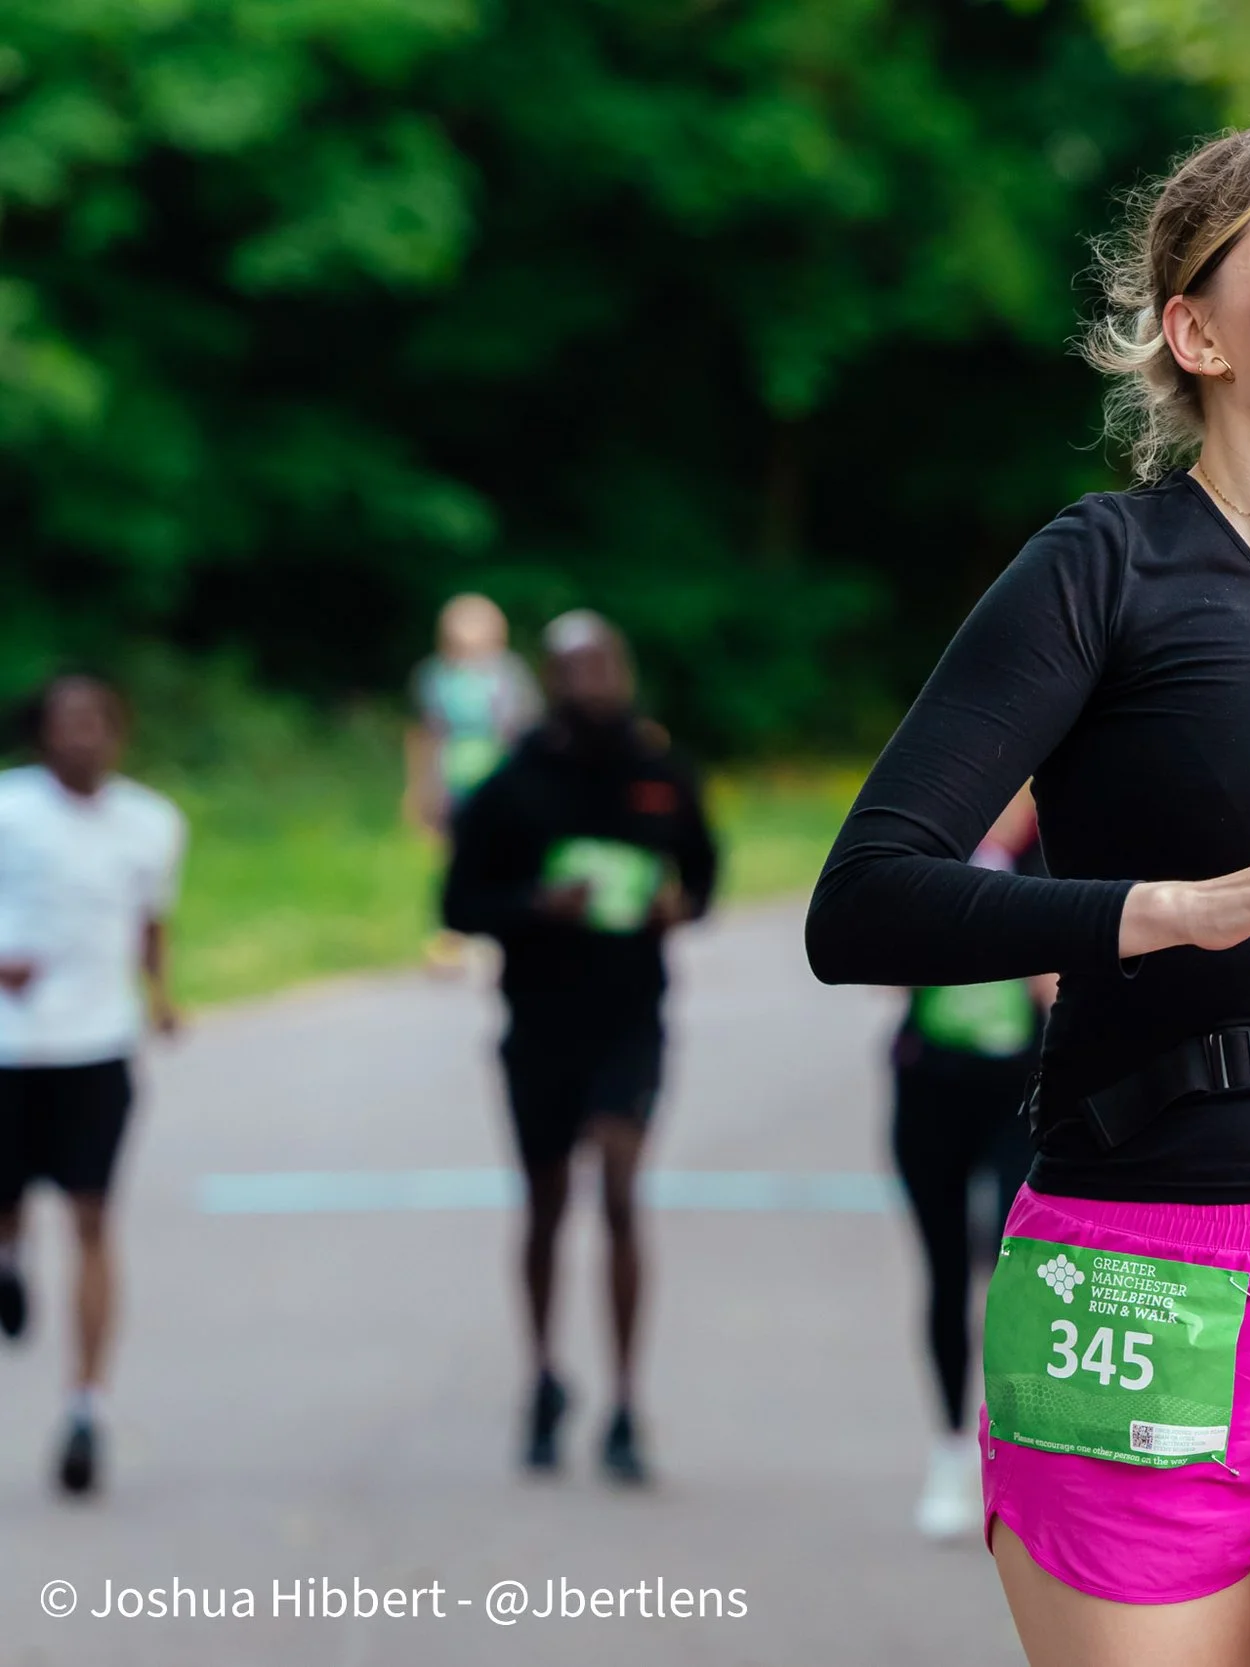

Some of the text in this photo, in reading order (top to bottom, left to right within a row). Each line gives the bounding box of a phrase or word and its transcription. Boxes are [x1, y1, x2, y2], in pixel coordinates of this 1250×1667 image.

[1093, 1257, 1156, 1277] GREATER
[1091, 1271, 1187, 1297] MANCHESTER
[1091, 1286, 1174, 1309] WELLBEING
[1089, 1300, 1178, 1323] RUN & WALK
[1046, 1319, 1154, 1391] 345
[1035, 1438, 1075, 1451] encourage
[1077, 1445, 1091, 1454] one
[1093, 1447, 1112, 1457] other
[1113, 1451, 1140, 1462] person
[1153, 1456, 1168, 1465] the
[1170, 1458, 1188, 1466] way
